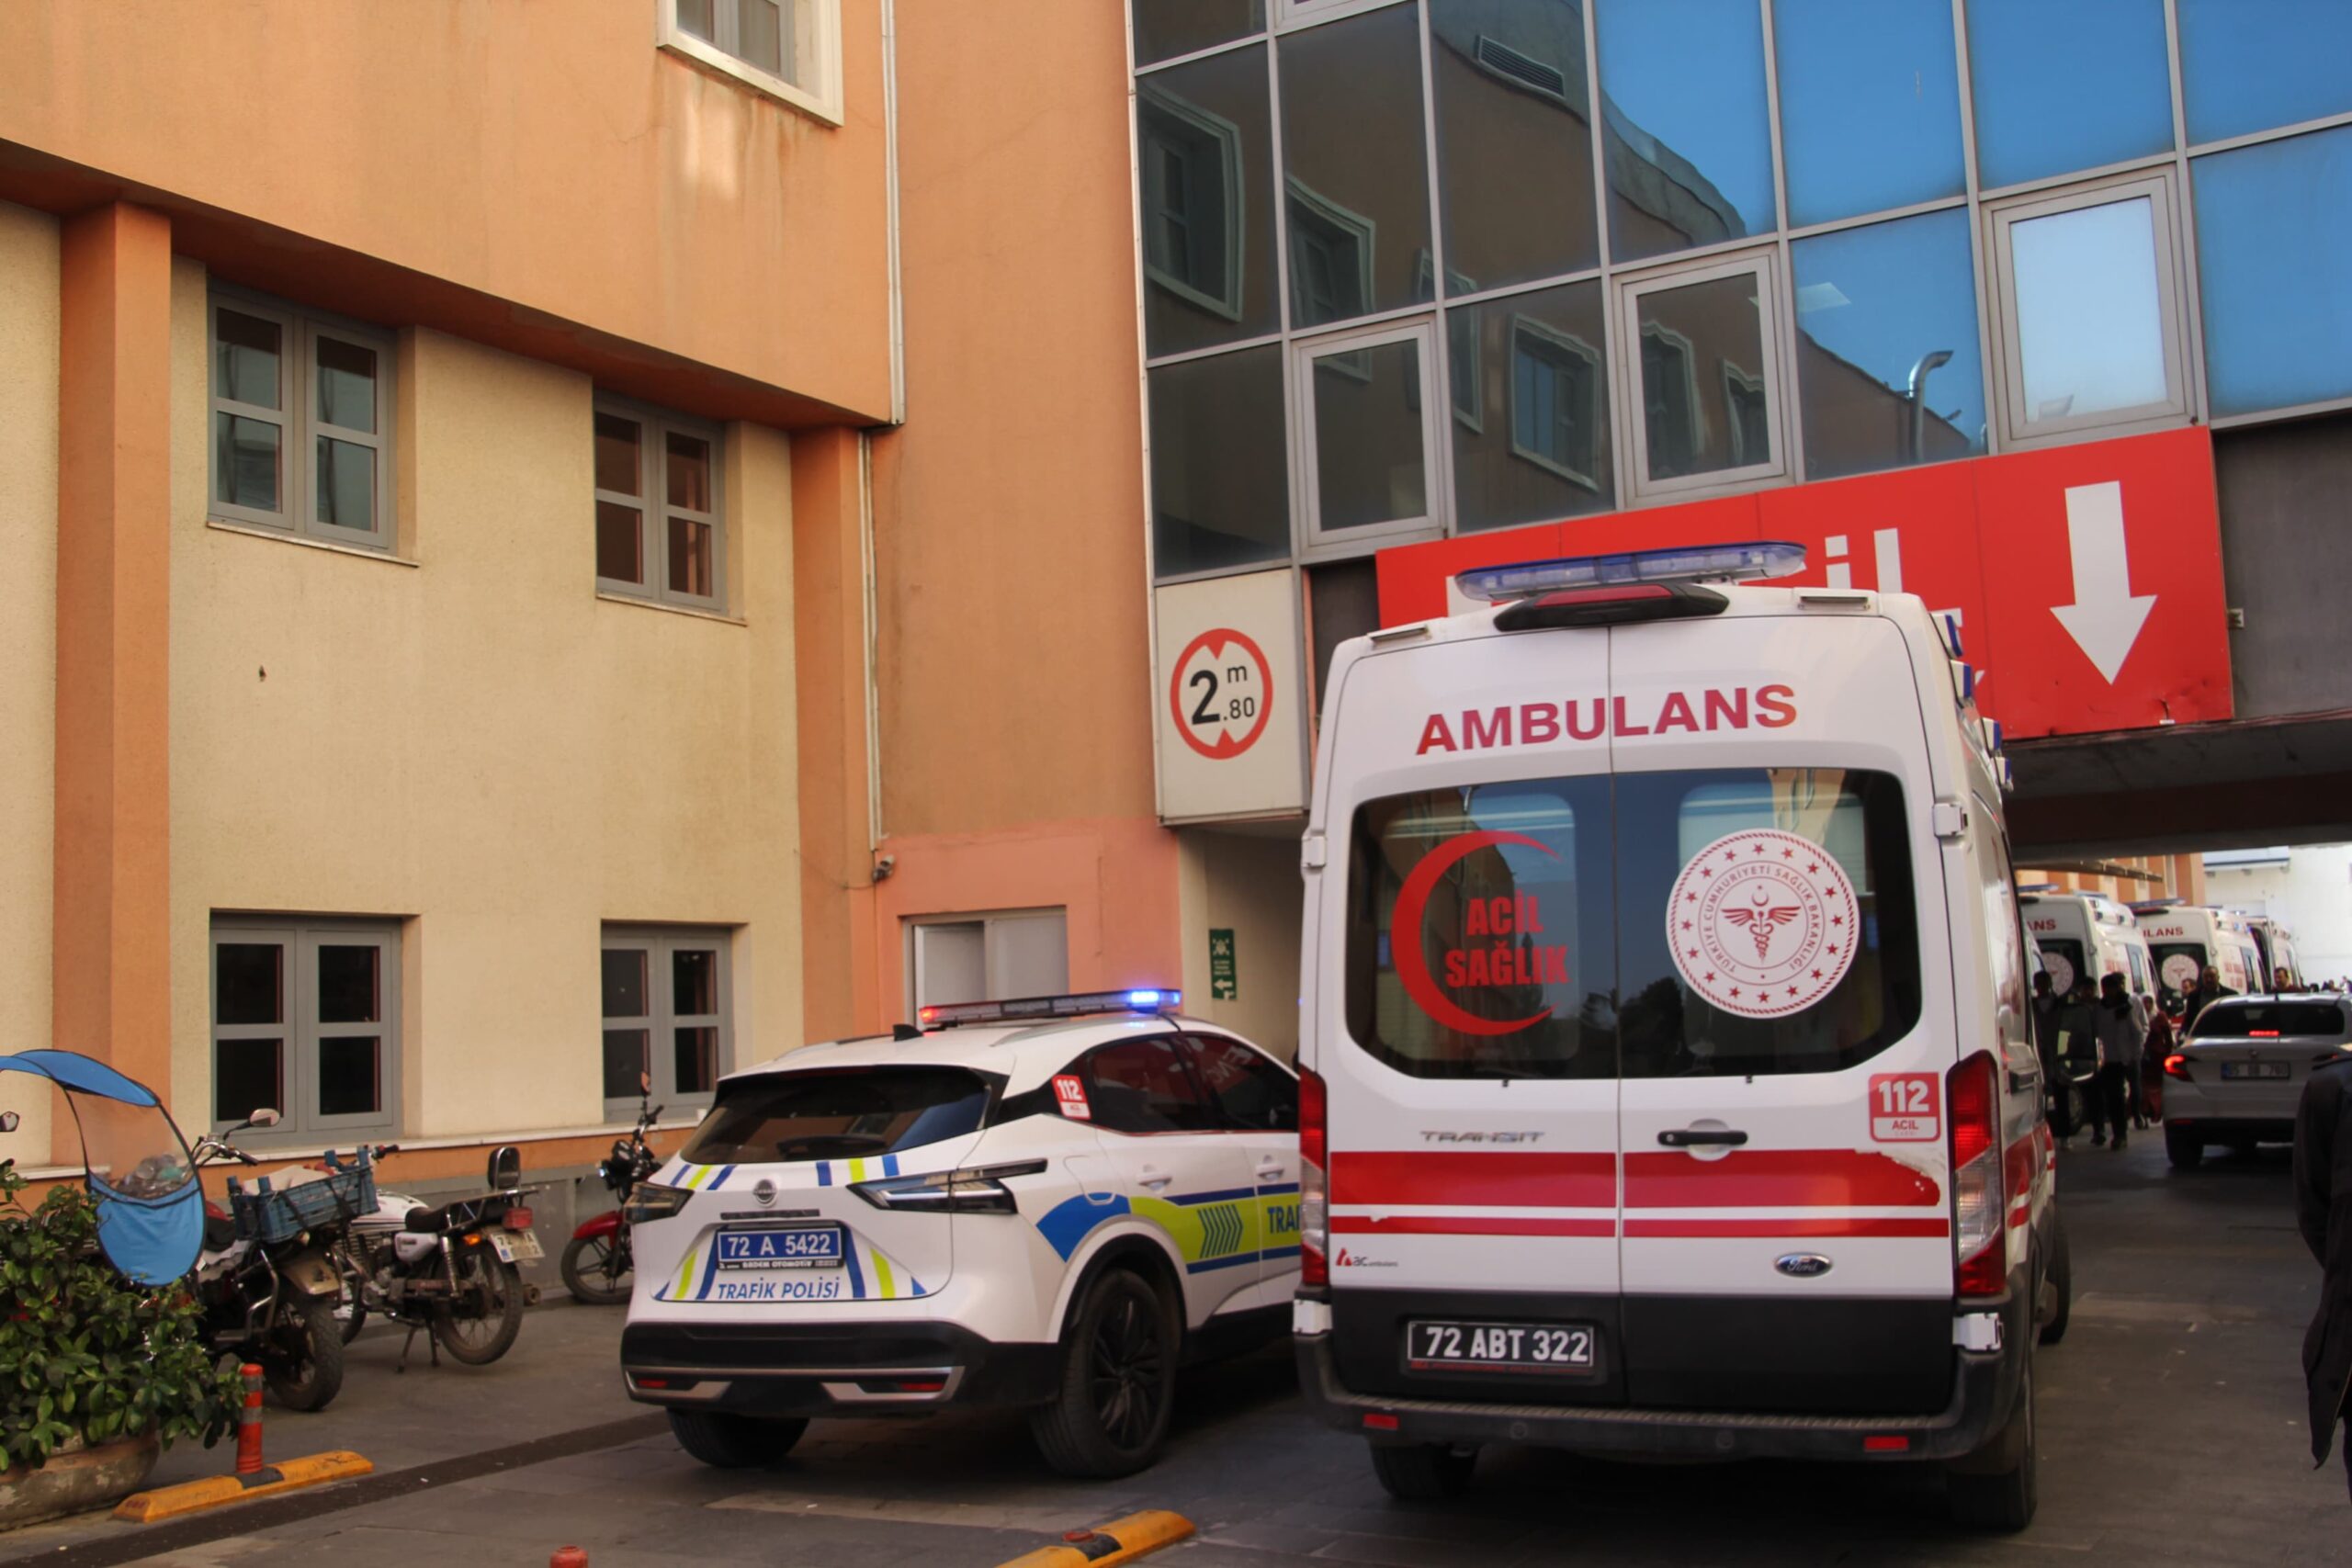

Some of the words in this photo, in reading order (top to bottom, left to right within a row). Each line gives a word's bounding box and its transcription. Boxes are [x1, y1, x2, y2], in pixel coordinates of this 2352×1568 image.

[1416, 683, 1797, 755] AMBULANS
[1775, 867, 1815, 903] SAĞLIK
[1466, 887, 1544, 936] ACİL
[1789, 904, 1821, 971] BAKANLIĞI
[1444, 940, 1570, 988] SAĞLIK
[1057, 1078, 1082, 1100] 112
[1878, 1079, 1929, 1112] 112
[728, 1236, 751, 1257] 72
[760, 1235, 775, 1256] A
[785, 1234, 831, 1255] 5422
[718, 1277, 776, 1300] TRAFİK
[781, 1276, 841, 1299] POLİSİ
[1426, 1326, 1462, 1358] 72
[1470, 1328, 1525, 1360] ABT
[1532, 1330, 1589, 1362] 322
